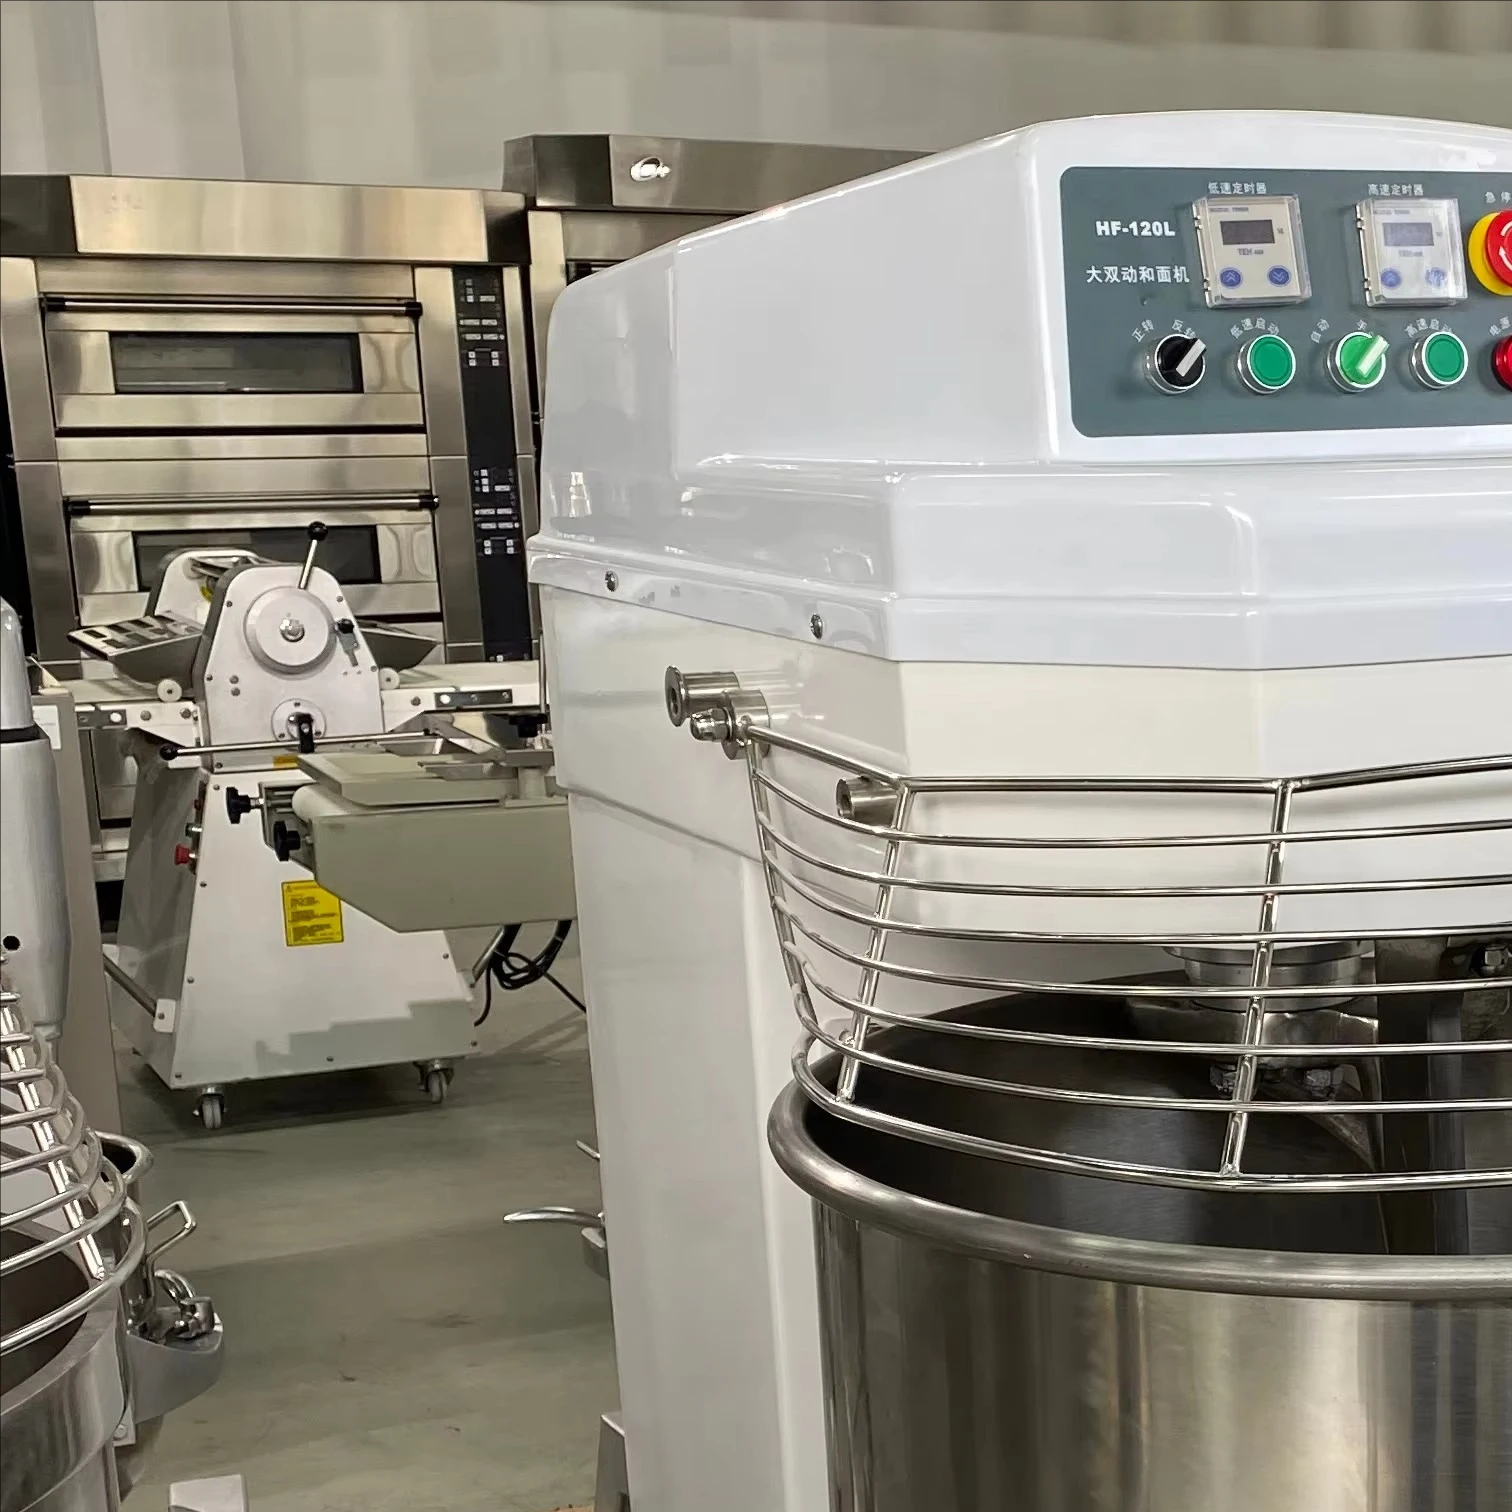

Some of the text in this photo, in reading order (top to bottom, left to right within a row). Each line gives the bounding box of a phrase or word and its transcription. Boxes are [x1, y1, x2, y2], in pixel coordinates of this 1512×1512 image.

[1208, 181, 1267, 195] 低速定时器
[1368, 183, 1424, 197] 高速定时器
[1095, 220, 1176, 236] HF-120L
[1085, 265, 1190, 283] 大双动和面机
